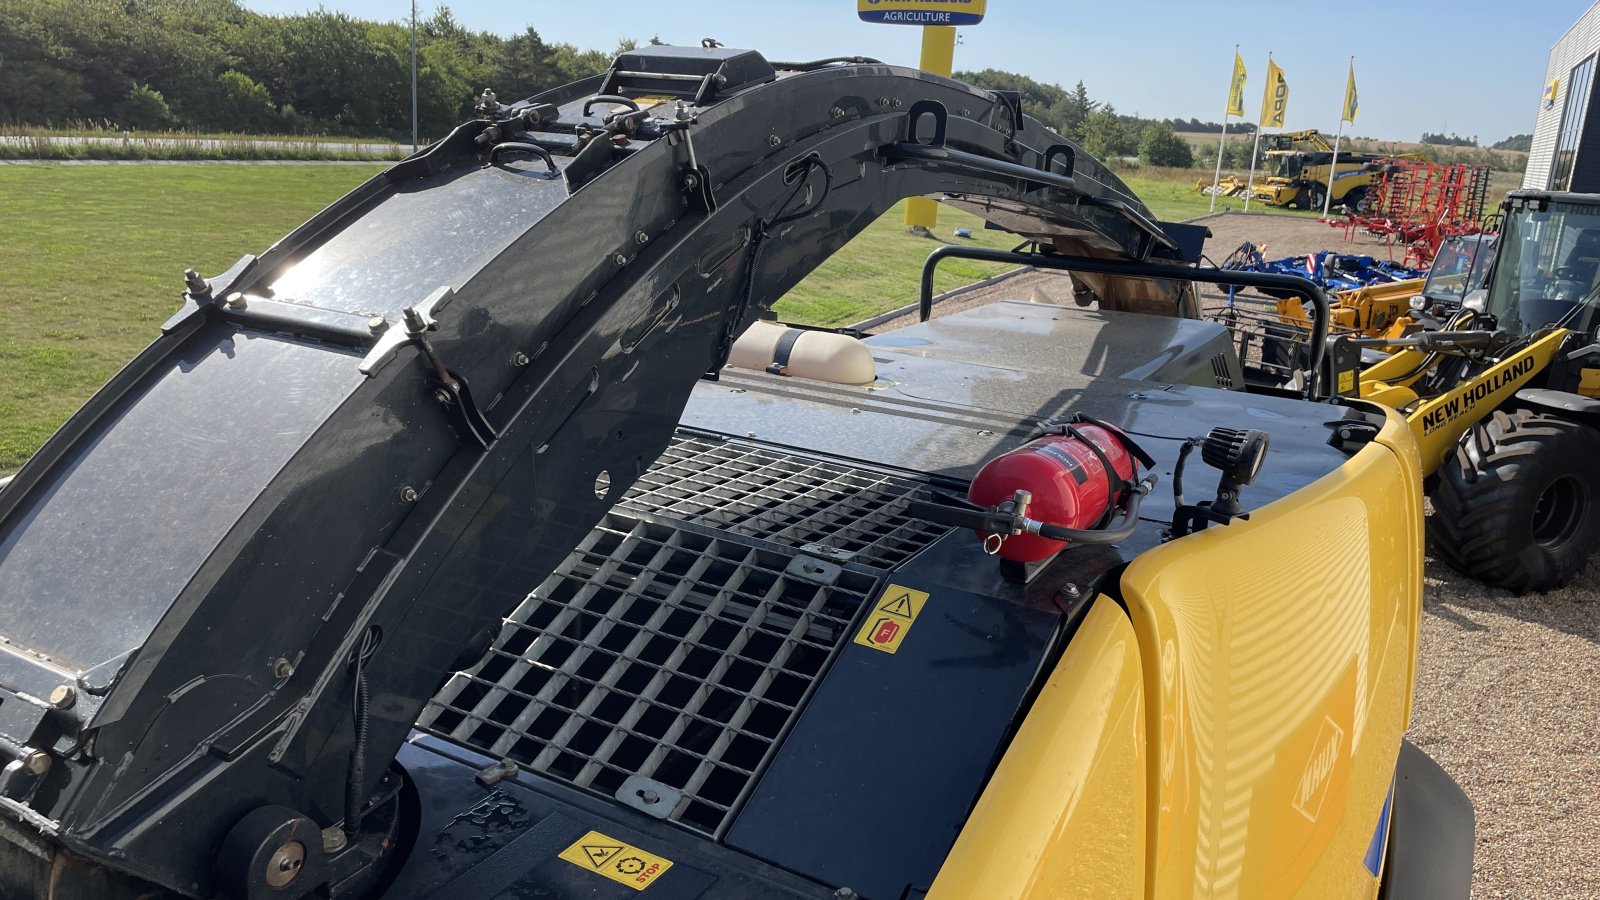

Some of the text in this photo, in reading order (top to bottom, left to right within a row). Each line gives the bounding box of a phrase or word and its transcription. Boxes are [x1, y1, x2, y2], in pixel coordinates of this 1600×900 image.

[883, 12, 951, 22] AGRICULTURE
[1423, 356, 1535, 431] NEW HOLLAND
[1424, 403, 1476, 437] LONG REACH
[635, 863, 660, 883] STOP
